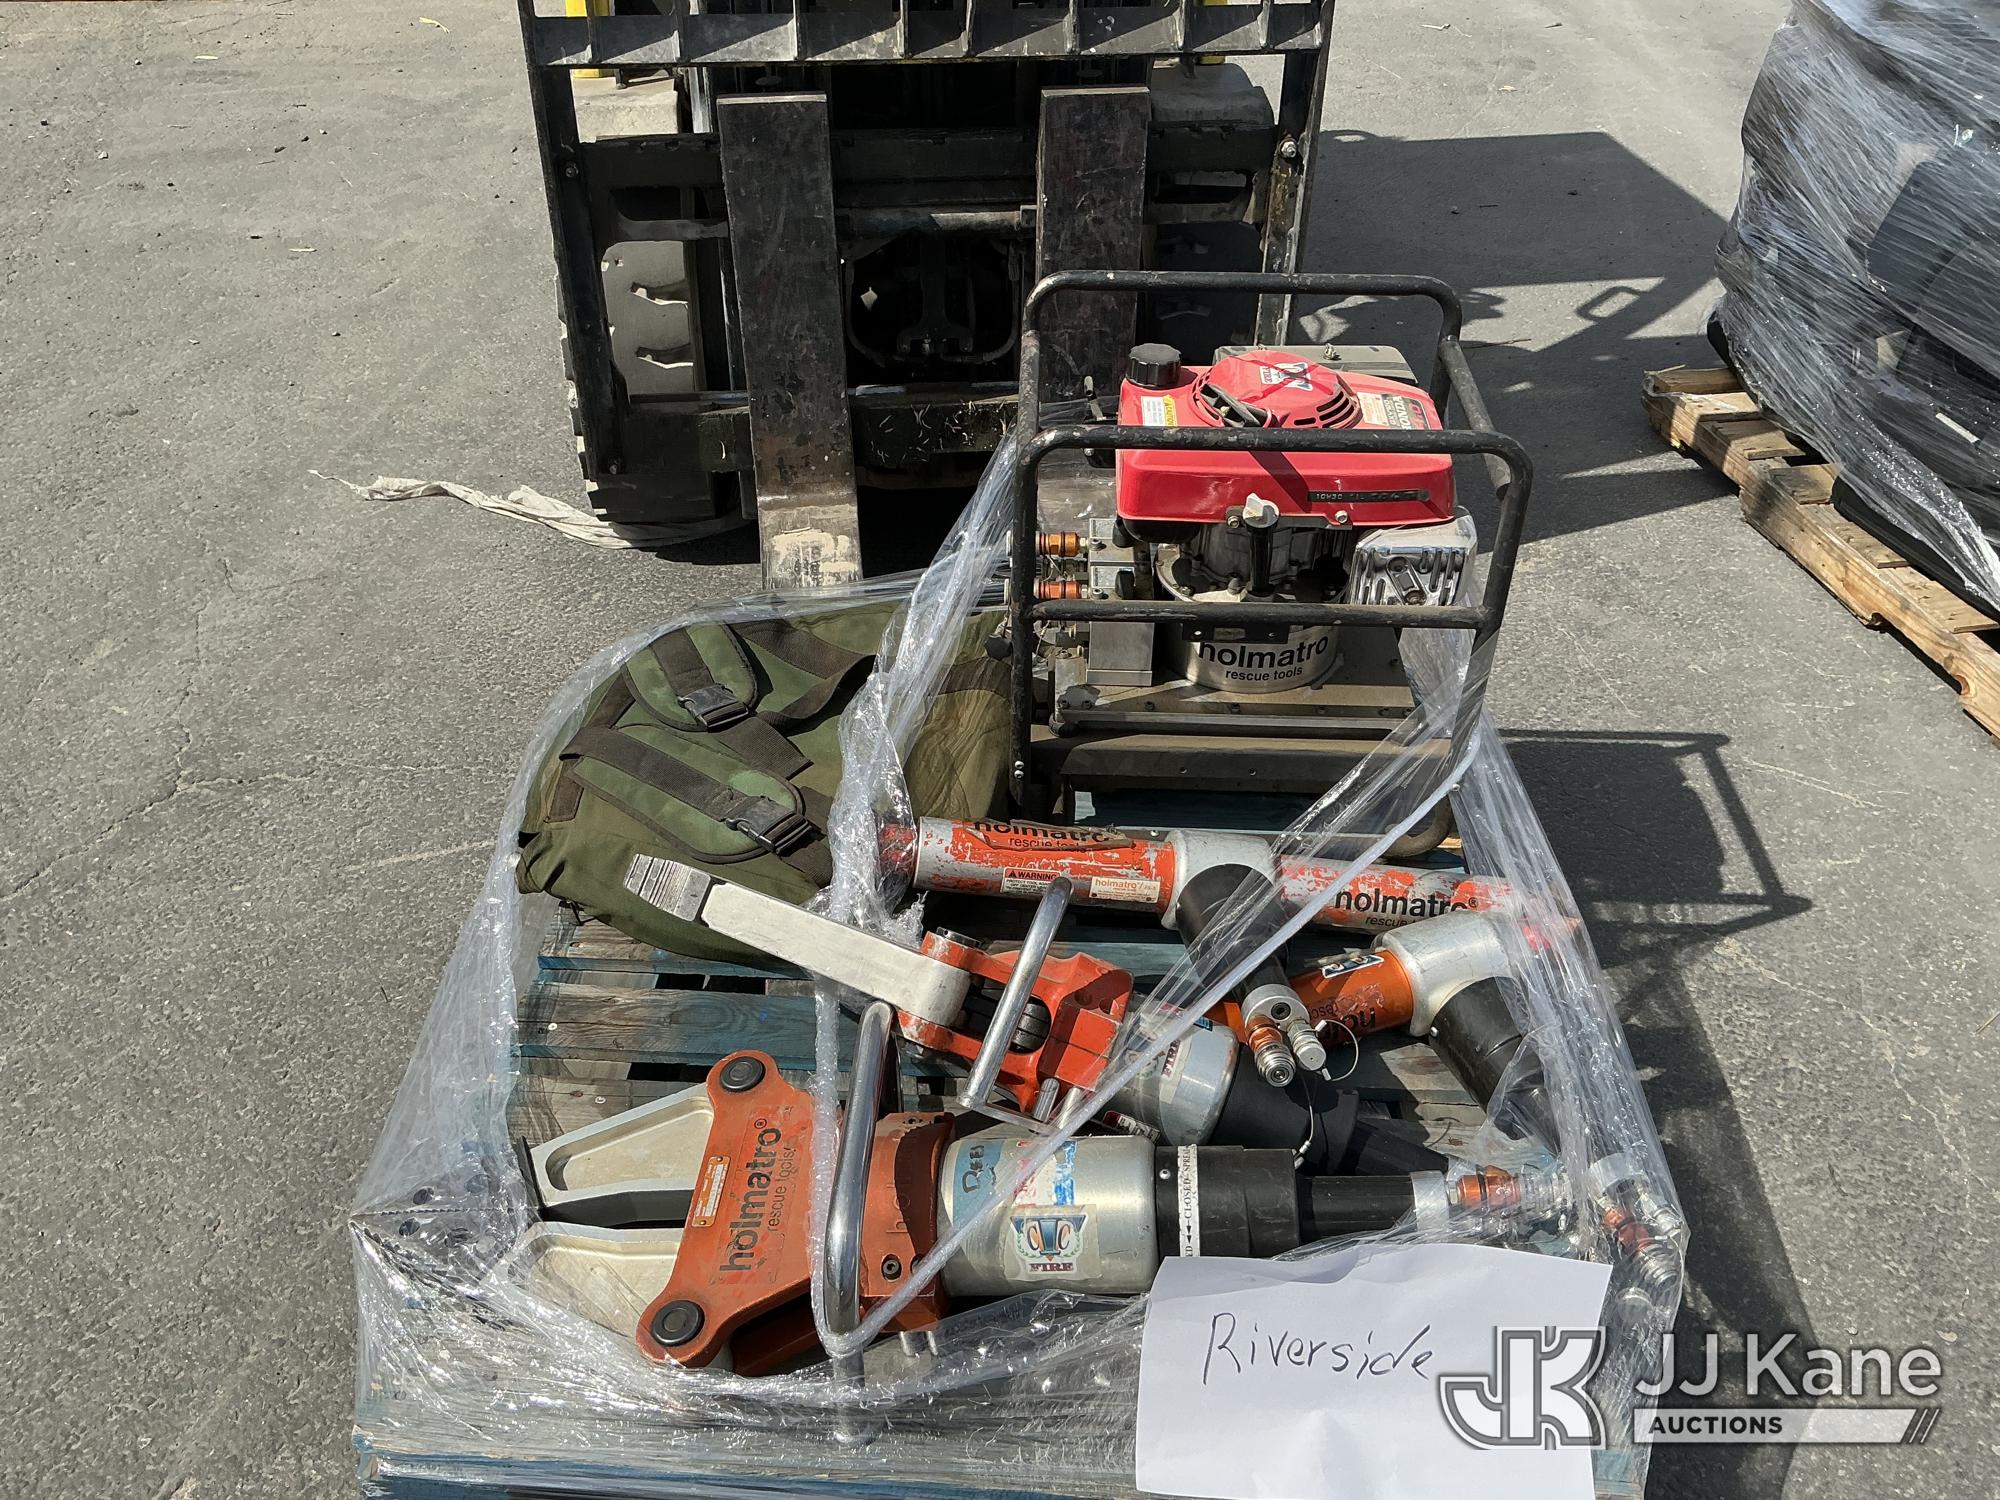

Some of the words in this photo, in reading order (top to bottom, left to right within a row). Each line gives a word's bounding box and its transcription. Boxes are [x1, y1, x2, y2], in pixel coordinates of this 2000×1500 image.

[1225, 669, 1270, 681] rescue
[1273, 666, 1303, 680] tools
[1018, 871, 1057, 880] WARNING
[1095, 878, 1138, 890] holmatro
[1183, 1178, 1192, 1219] CLOSED
[768, 1187, 787, 1232] rescue
[1029, 1262, 1074, 1272] FIRE
[1202, 1312, 1434, 1385] Riverside
